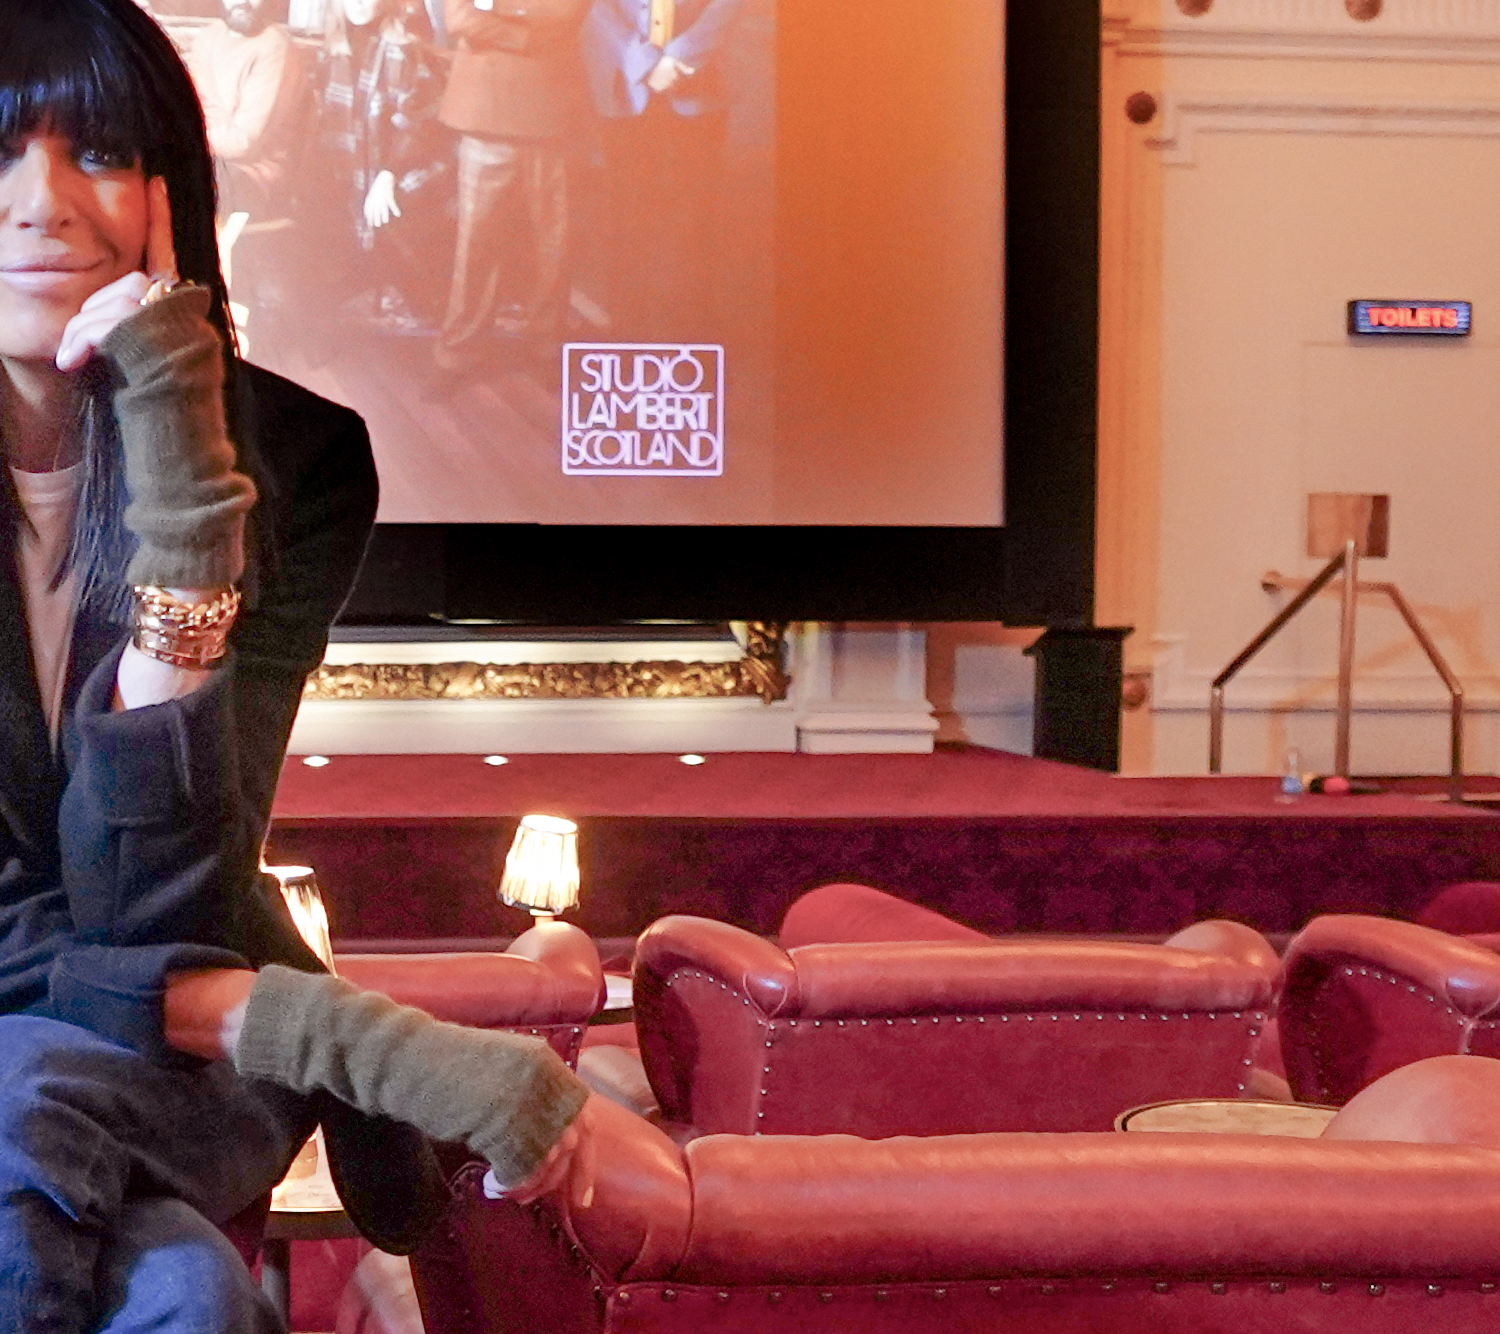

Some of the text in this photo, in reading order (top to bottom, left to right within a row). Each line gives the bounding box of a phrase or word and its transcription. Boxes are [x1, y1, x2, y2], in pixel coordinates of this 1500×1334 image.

[1367, 307, 1458, 328] TOILETS
[580, 353, 704, 393] STUDIO
[571, 392, 715, 431] LAMBERT
[566, 430, 718, 467] SCOTLAND
